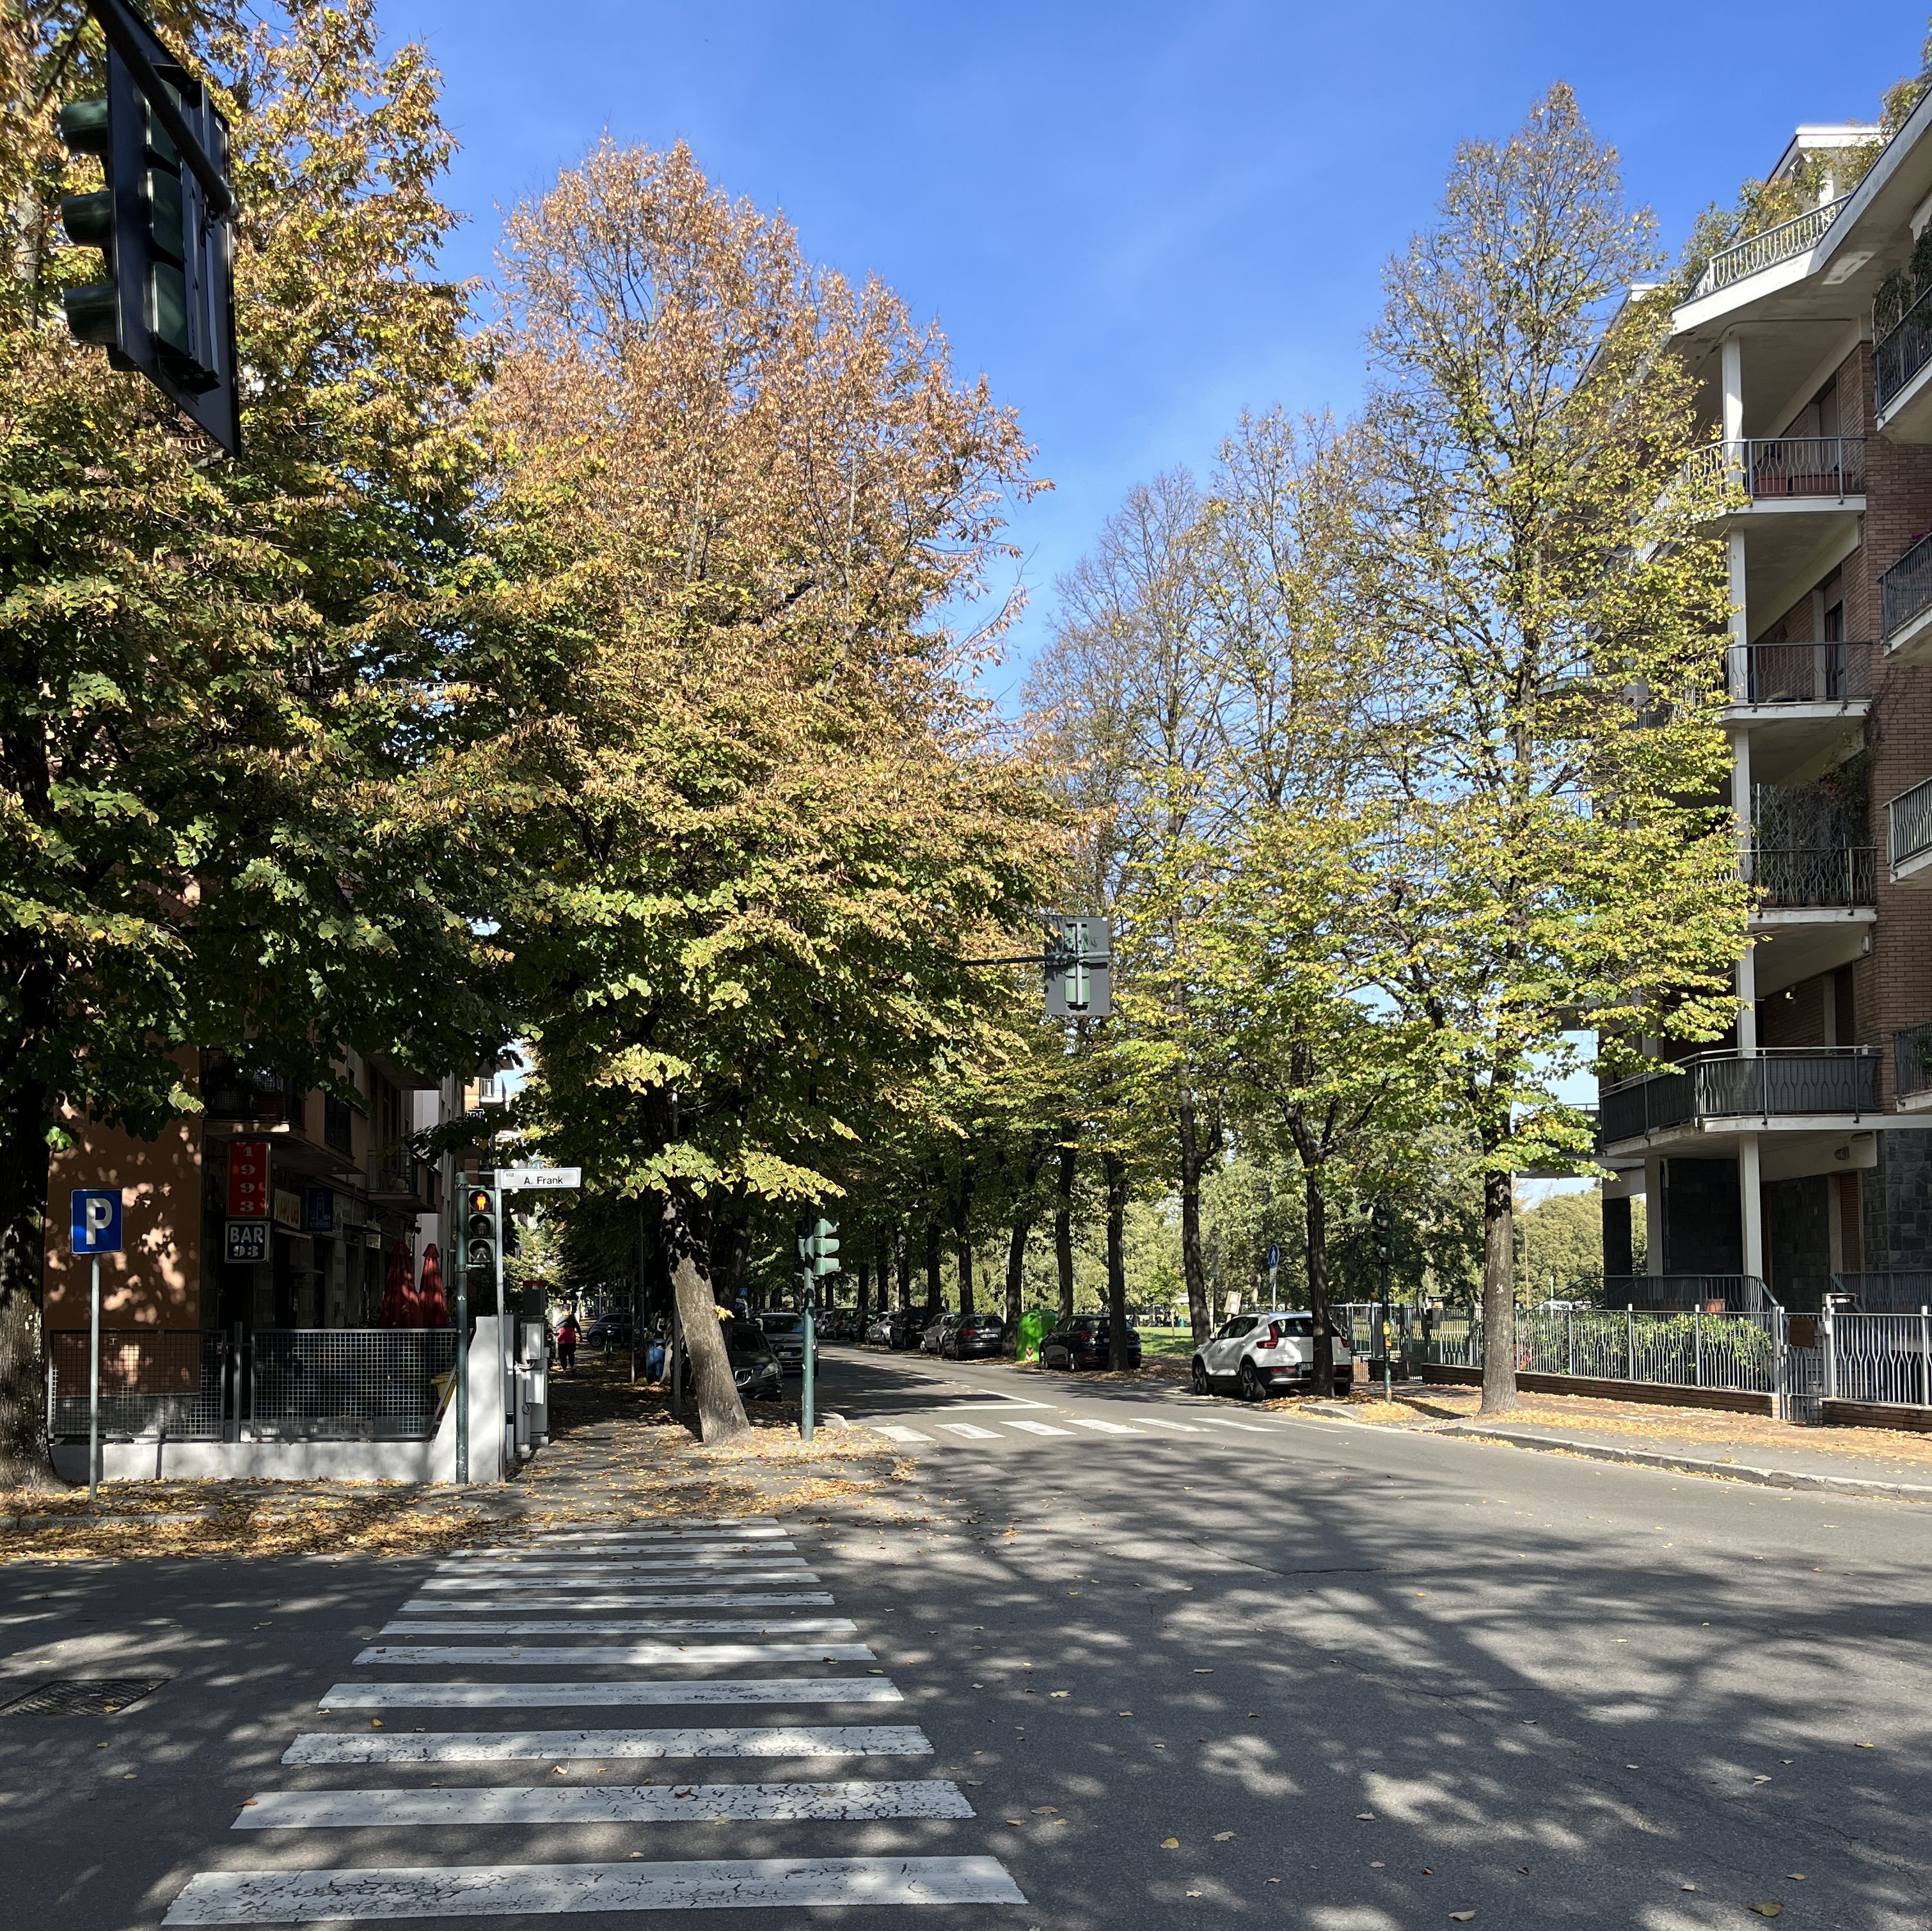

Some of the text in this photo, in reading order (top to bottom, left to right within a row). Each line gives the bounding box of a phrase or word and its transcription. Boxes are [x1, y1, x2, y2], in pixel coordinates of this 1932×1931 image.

[240, 1146, 255, 1212] 1993
[537, 1176, 564, 1185] Frank
[86, 1198, 113, 1245] P
[230, 1227, 264, 1243] BAR
[233, 1245, 259, 1257] 93
